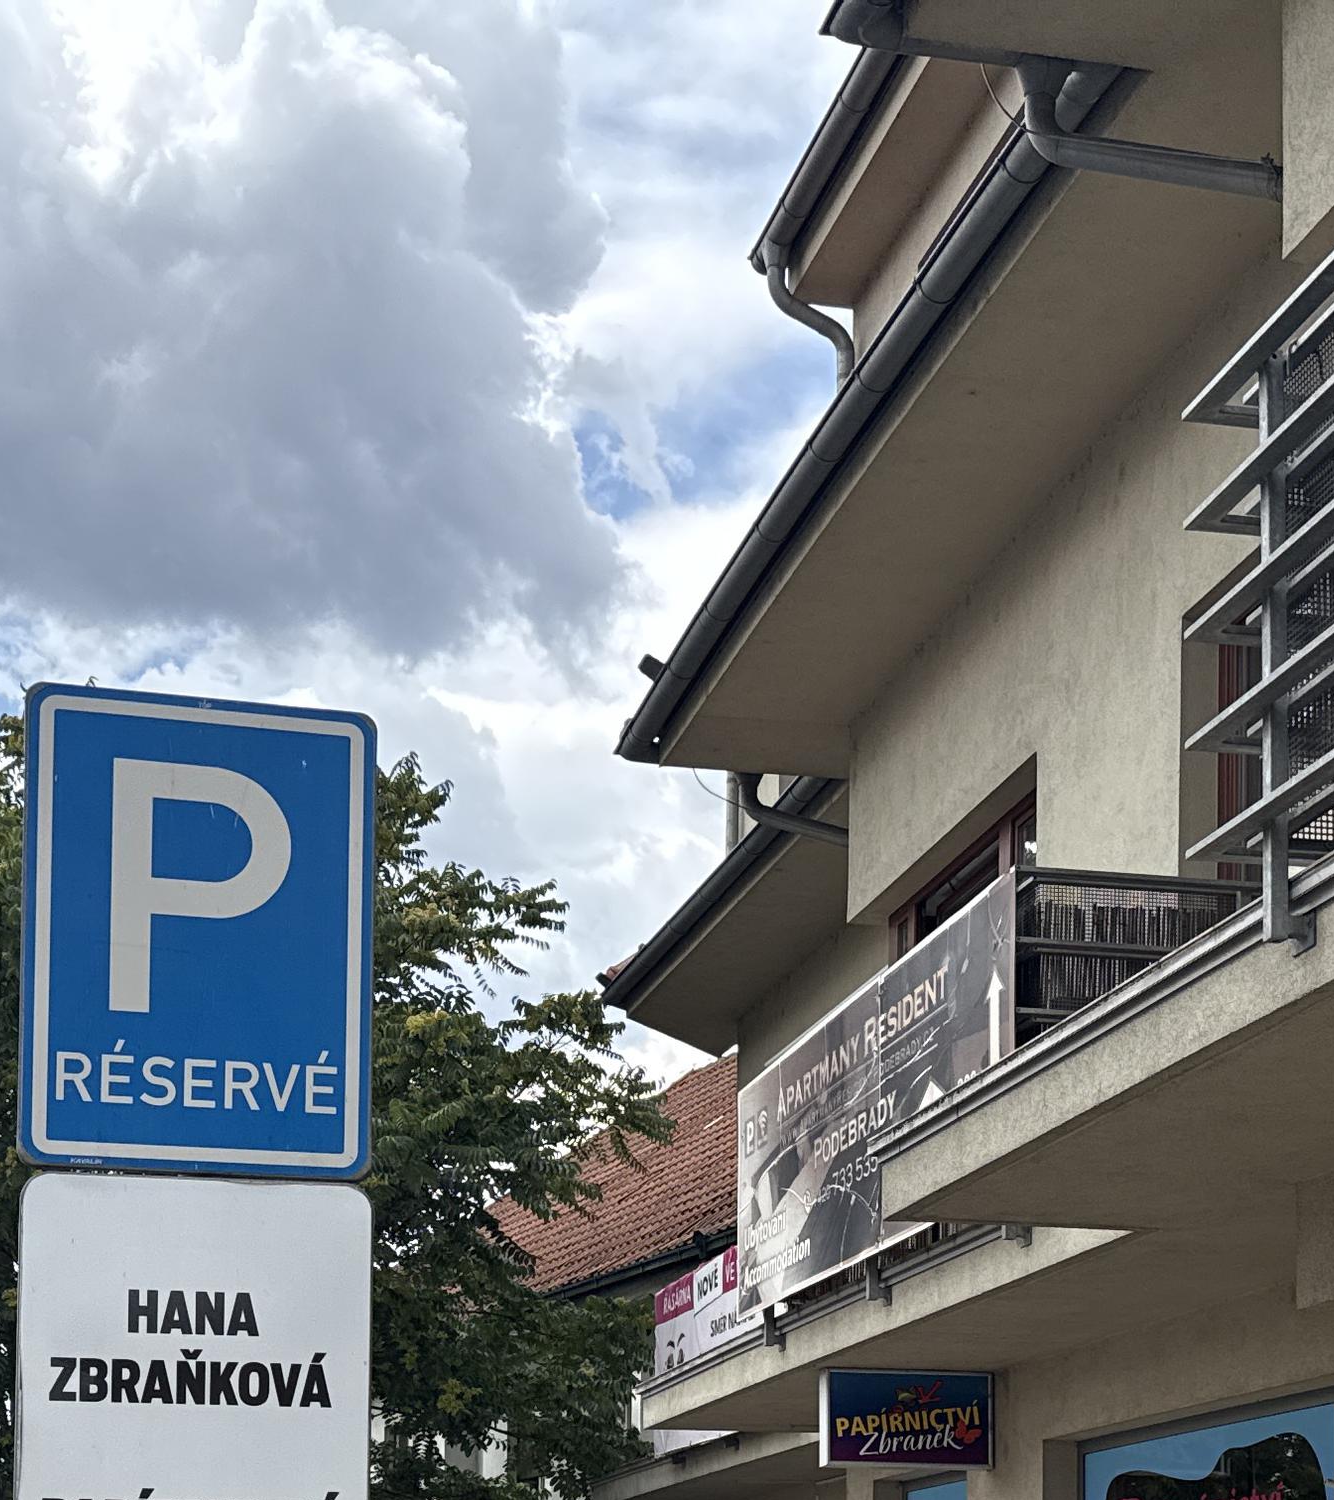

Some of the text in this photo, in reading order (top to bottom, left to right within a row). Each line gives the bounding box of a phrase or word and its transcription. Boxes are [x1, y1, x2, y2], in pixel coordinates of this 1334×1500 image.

[109, 758, 292, 1013] P
[777, 966, 950, 1122] APARTMANY RESIDENT
[55, 1040, 339, 1115] RÉSERVÉ
[832, 1163, 853, 1196] 733
[743, 1238, 811, 1289] Accommodation
[127, 1289, 259, 1336] HANA
[48, 1349, 332, 1408] ZBRAŇKOVÁ
[835, 1400, 981, 1438] PAPÍRNICTVÍ
